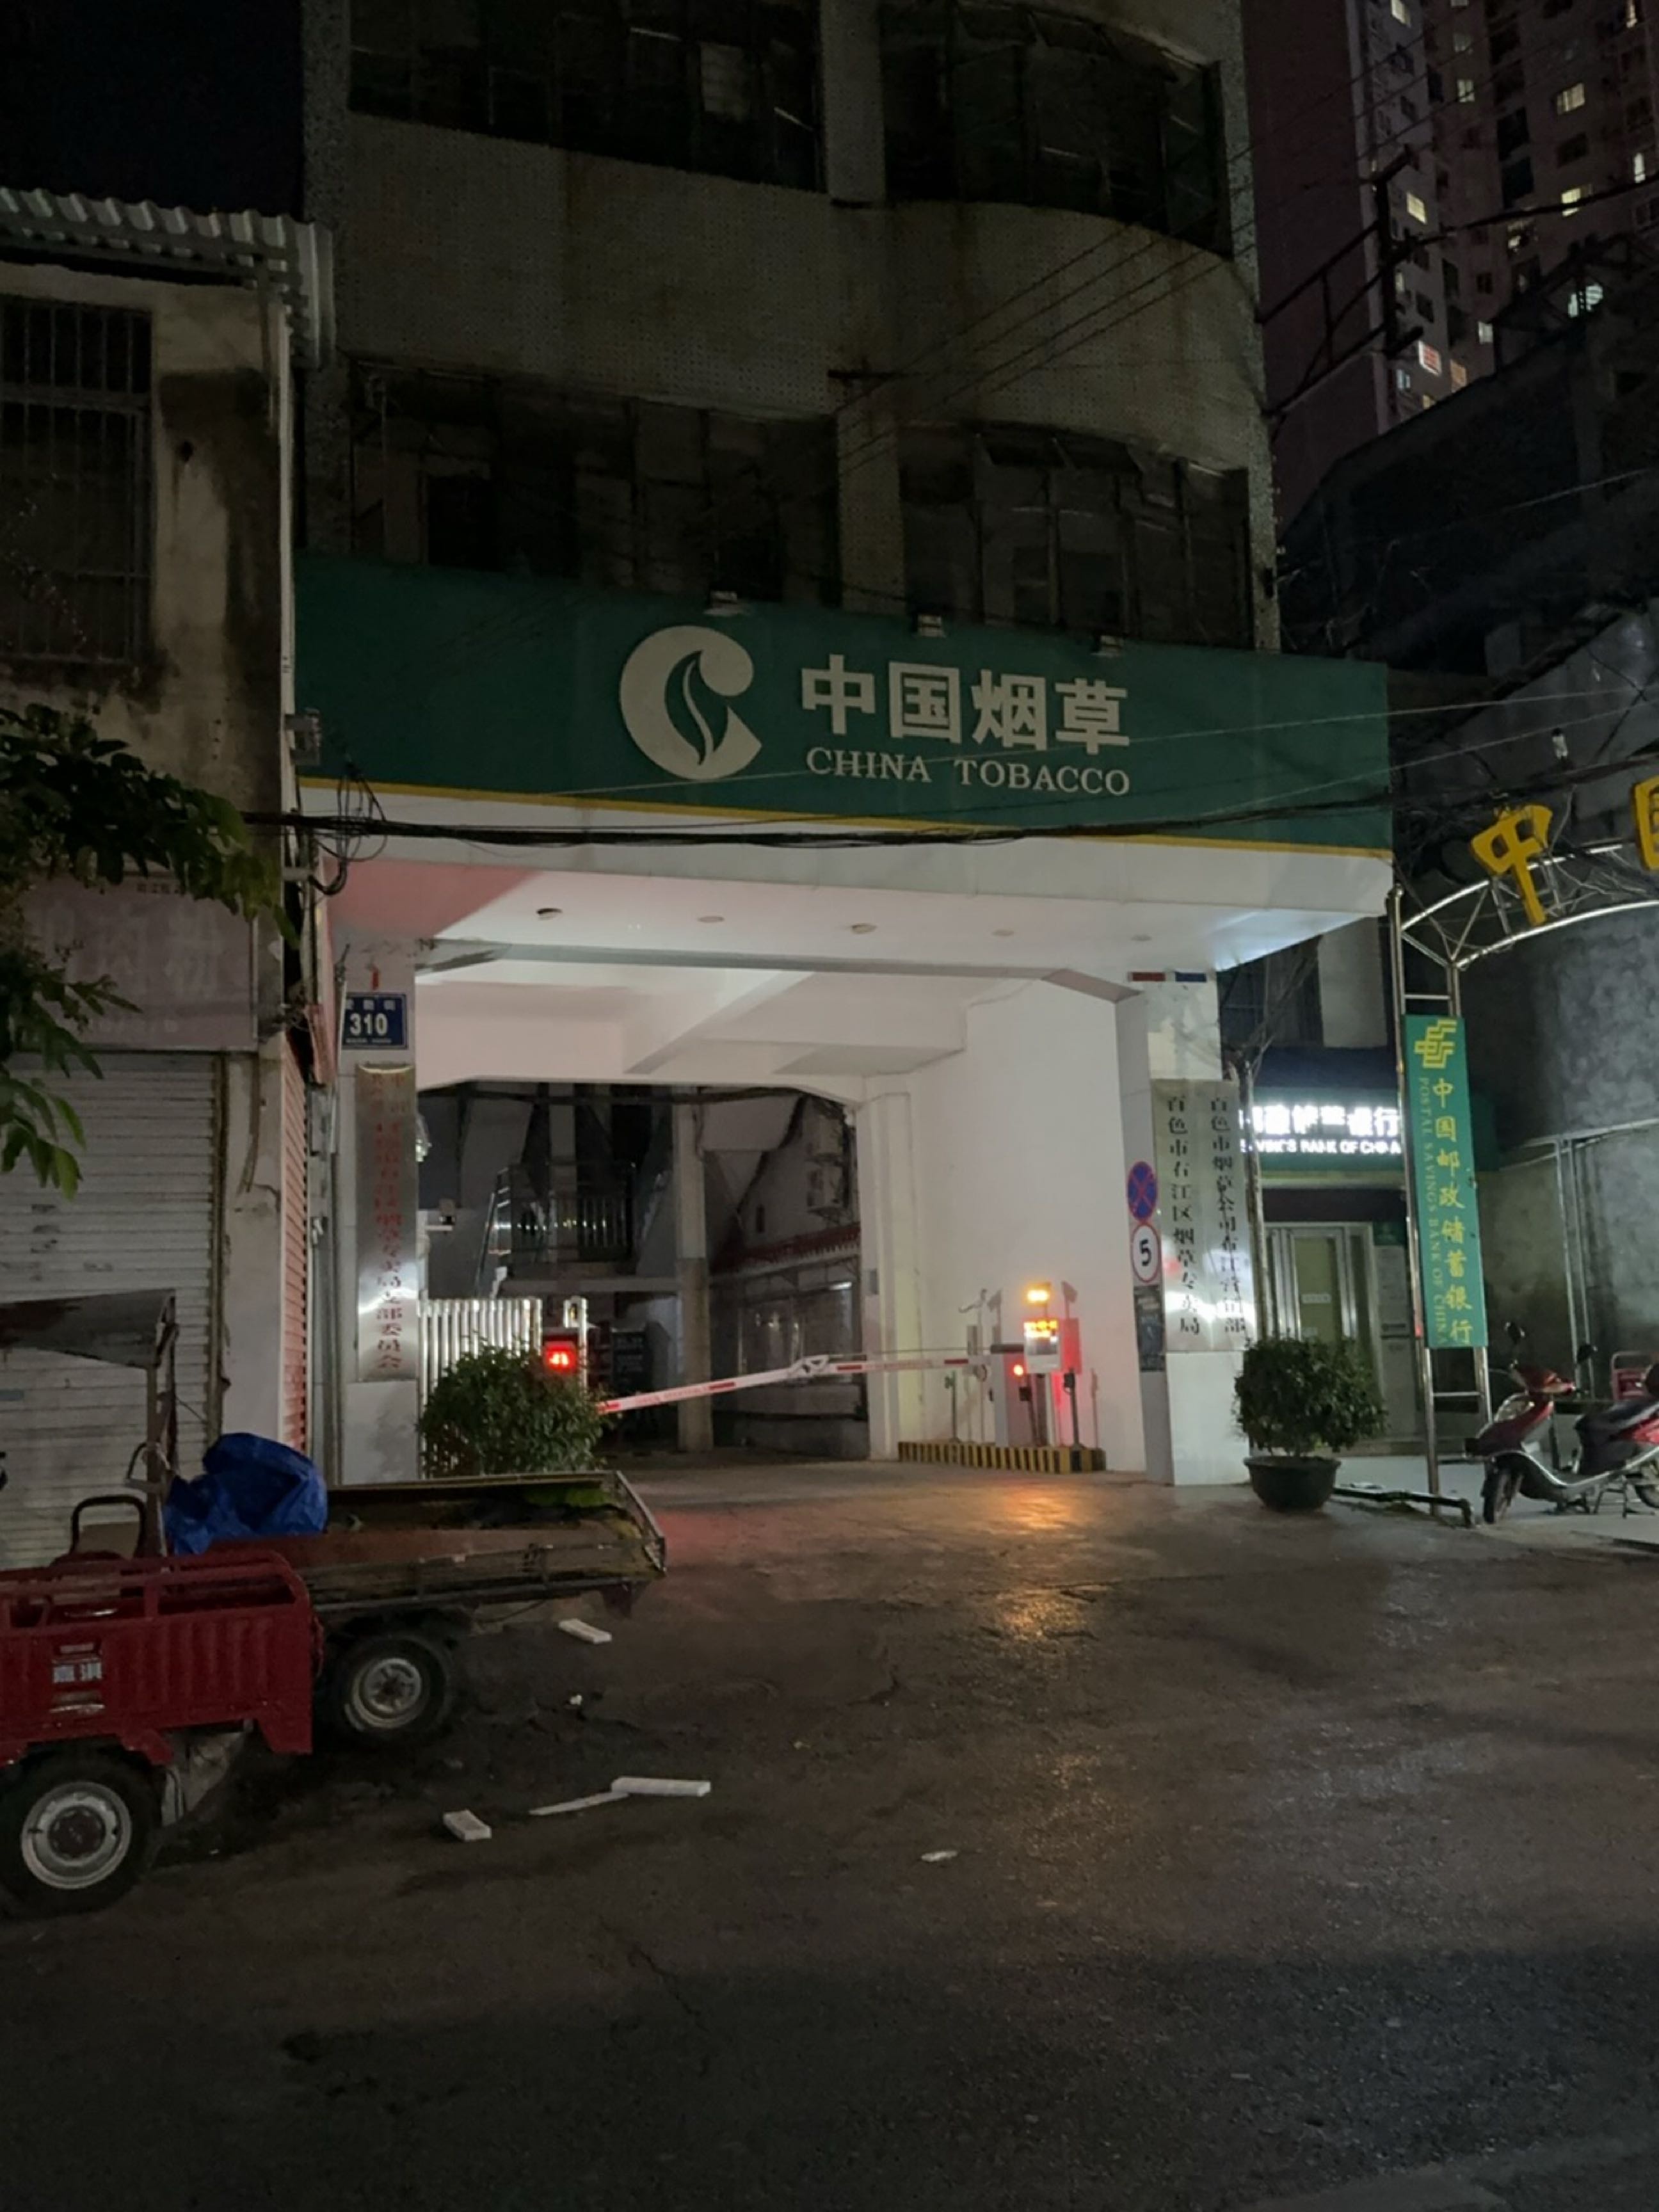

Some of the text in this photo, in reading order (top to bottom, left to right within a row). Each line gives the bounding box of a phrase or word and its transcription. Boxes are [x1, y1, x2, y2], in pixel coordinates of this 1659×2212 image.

[801, 653, 1130, 755] 中国烟草
[806, 747, 1130, 796] CHINA TOBACCO
[349, 1012, 389, 1036] 310
[1419, 1077, 1432, 1136] POSTAL
[1423, 1142, 1438, 1213] SAVINGS
[1432, 1077, 1473, 1345] 中国邮政储蓄银行
[1139, 1238, 1151, 1267] 5
[1428, 1219, 1441, 1261] BANK
[1434, 1294, 1447, 1344] CHINA
